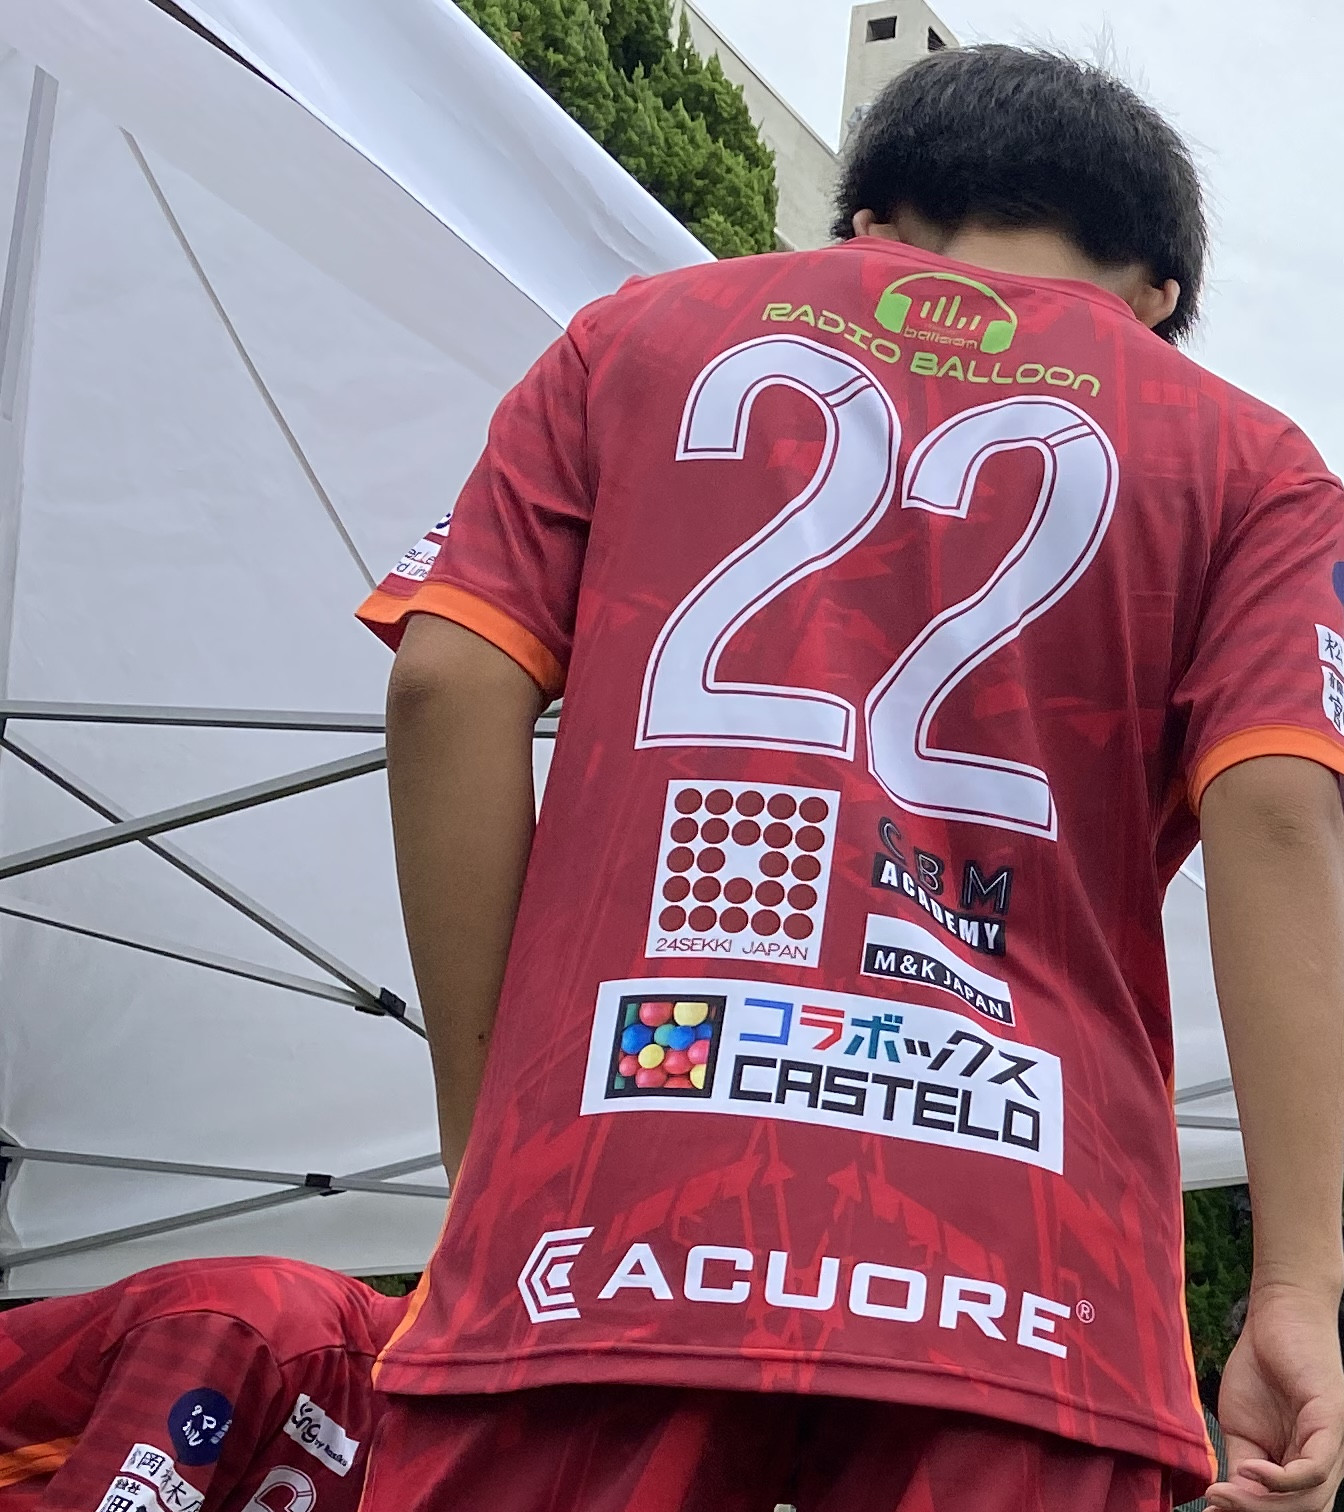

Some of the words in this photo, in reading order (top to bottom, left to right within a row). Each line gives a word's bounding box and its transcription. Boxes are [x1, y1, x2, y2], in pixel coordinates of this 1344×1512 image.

[761, 302, 902, 364] RADIO
[910, 351, 1101, 398] BALLOON
[635, 333, 1120, 842] 22
[656, 937, 733, 954] 24SEKKI
[742, 940, 810, 961] JAPAN
[880, 860, 1001, 951] ACADEMY
[874, 950, 936, 980] M&K
[942, 970, 1004, 1019] JAPAN
[739, 997, 1041, 1102] コラボックス
[729, 1054, 1041, 1153] CASTELO
[597, 1240, 1071, 1359] ACUORE
